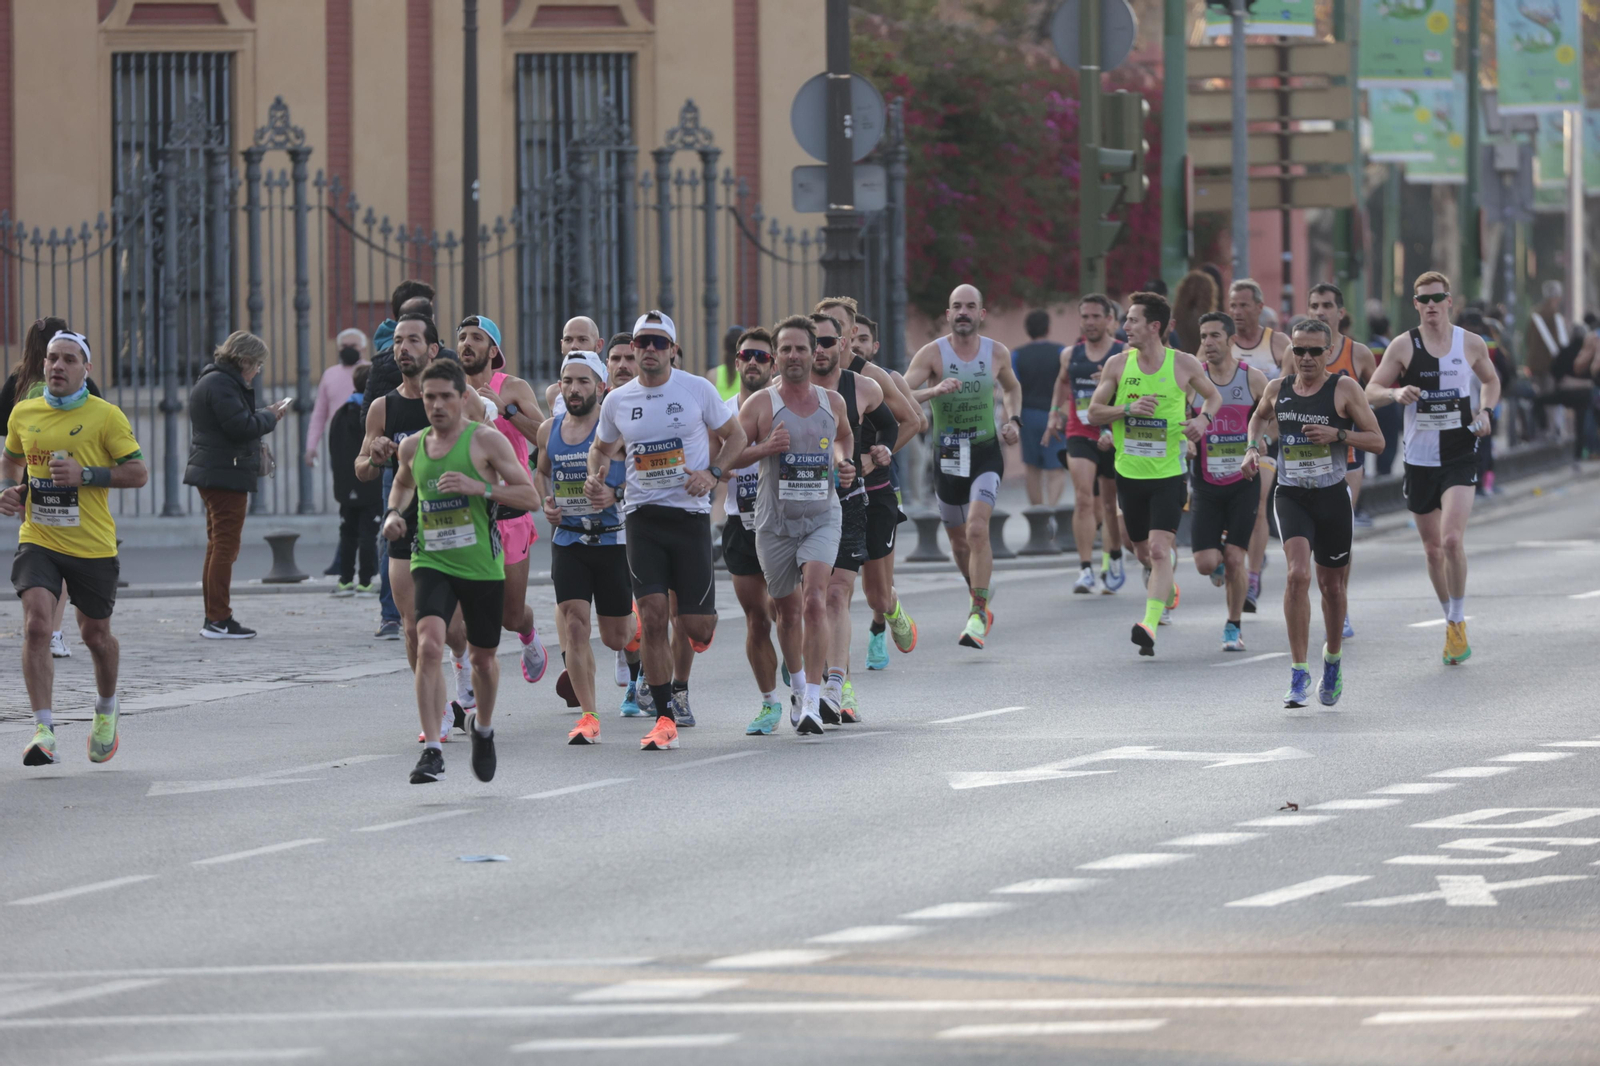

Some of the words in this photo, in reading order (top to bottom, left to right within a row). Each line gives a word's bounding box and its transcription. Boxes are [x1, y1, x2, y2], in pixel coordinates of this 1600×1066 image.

[1430, 390, 1455, 398] ZURICH
[1137, 419, 1162, 427] ZURICH
[1297, 413, 1329, 425] KACHOPOS
[647, 441, 677, 452] ZURICH
[1300, 450, 1312, 458] 915
[650, 458, 667, 467] 3737
[797, 455, 825, 463] ZURICH
[646, 468, 665, 478] ANDRÉ
[796, 470, 814, 479] 2638
[788, 481, 822, 489] BARRUNCHO
[567, 487, 583, 495] 1170
[42, 495, 61, 504] 1963
[431, 499, 462, 511] ZURICH
[436, 529, 457, 538] JORGE
